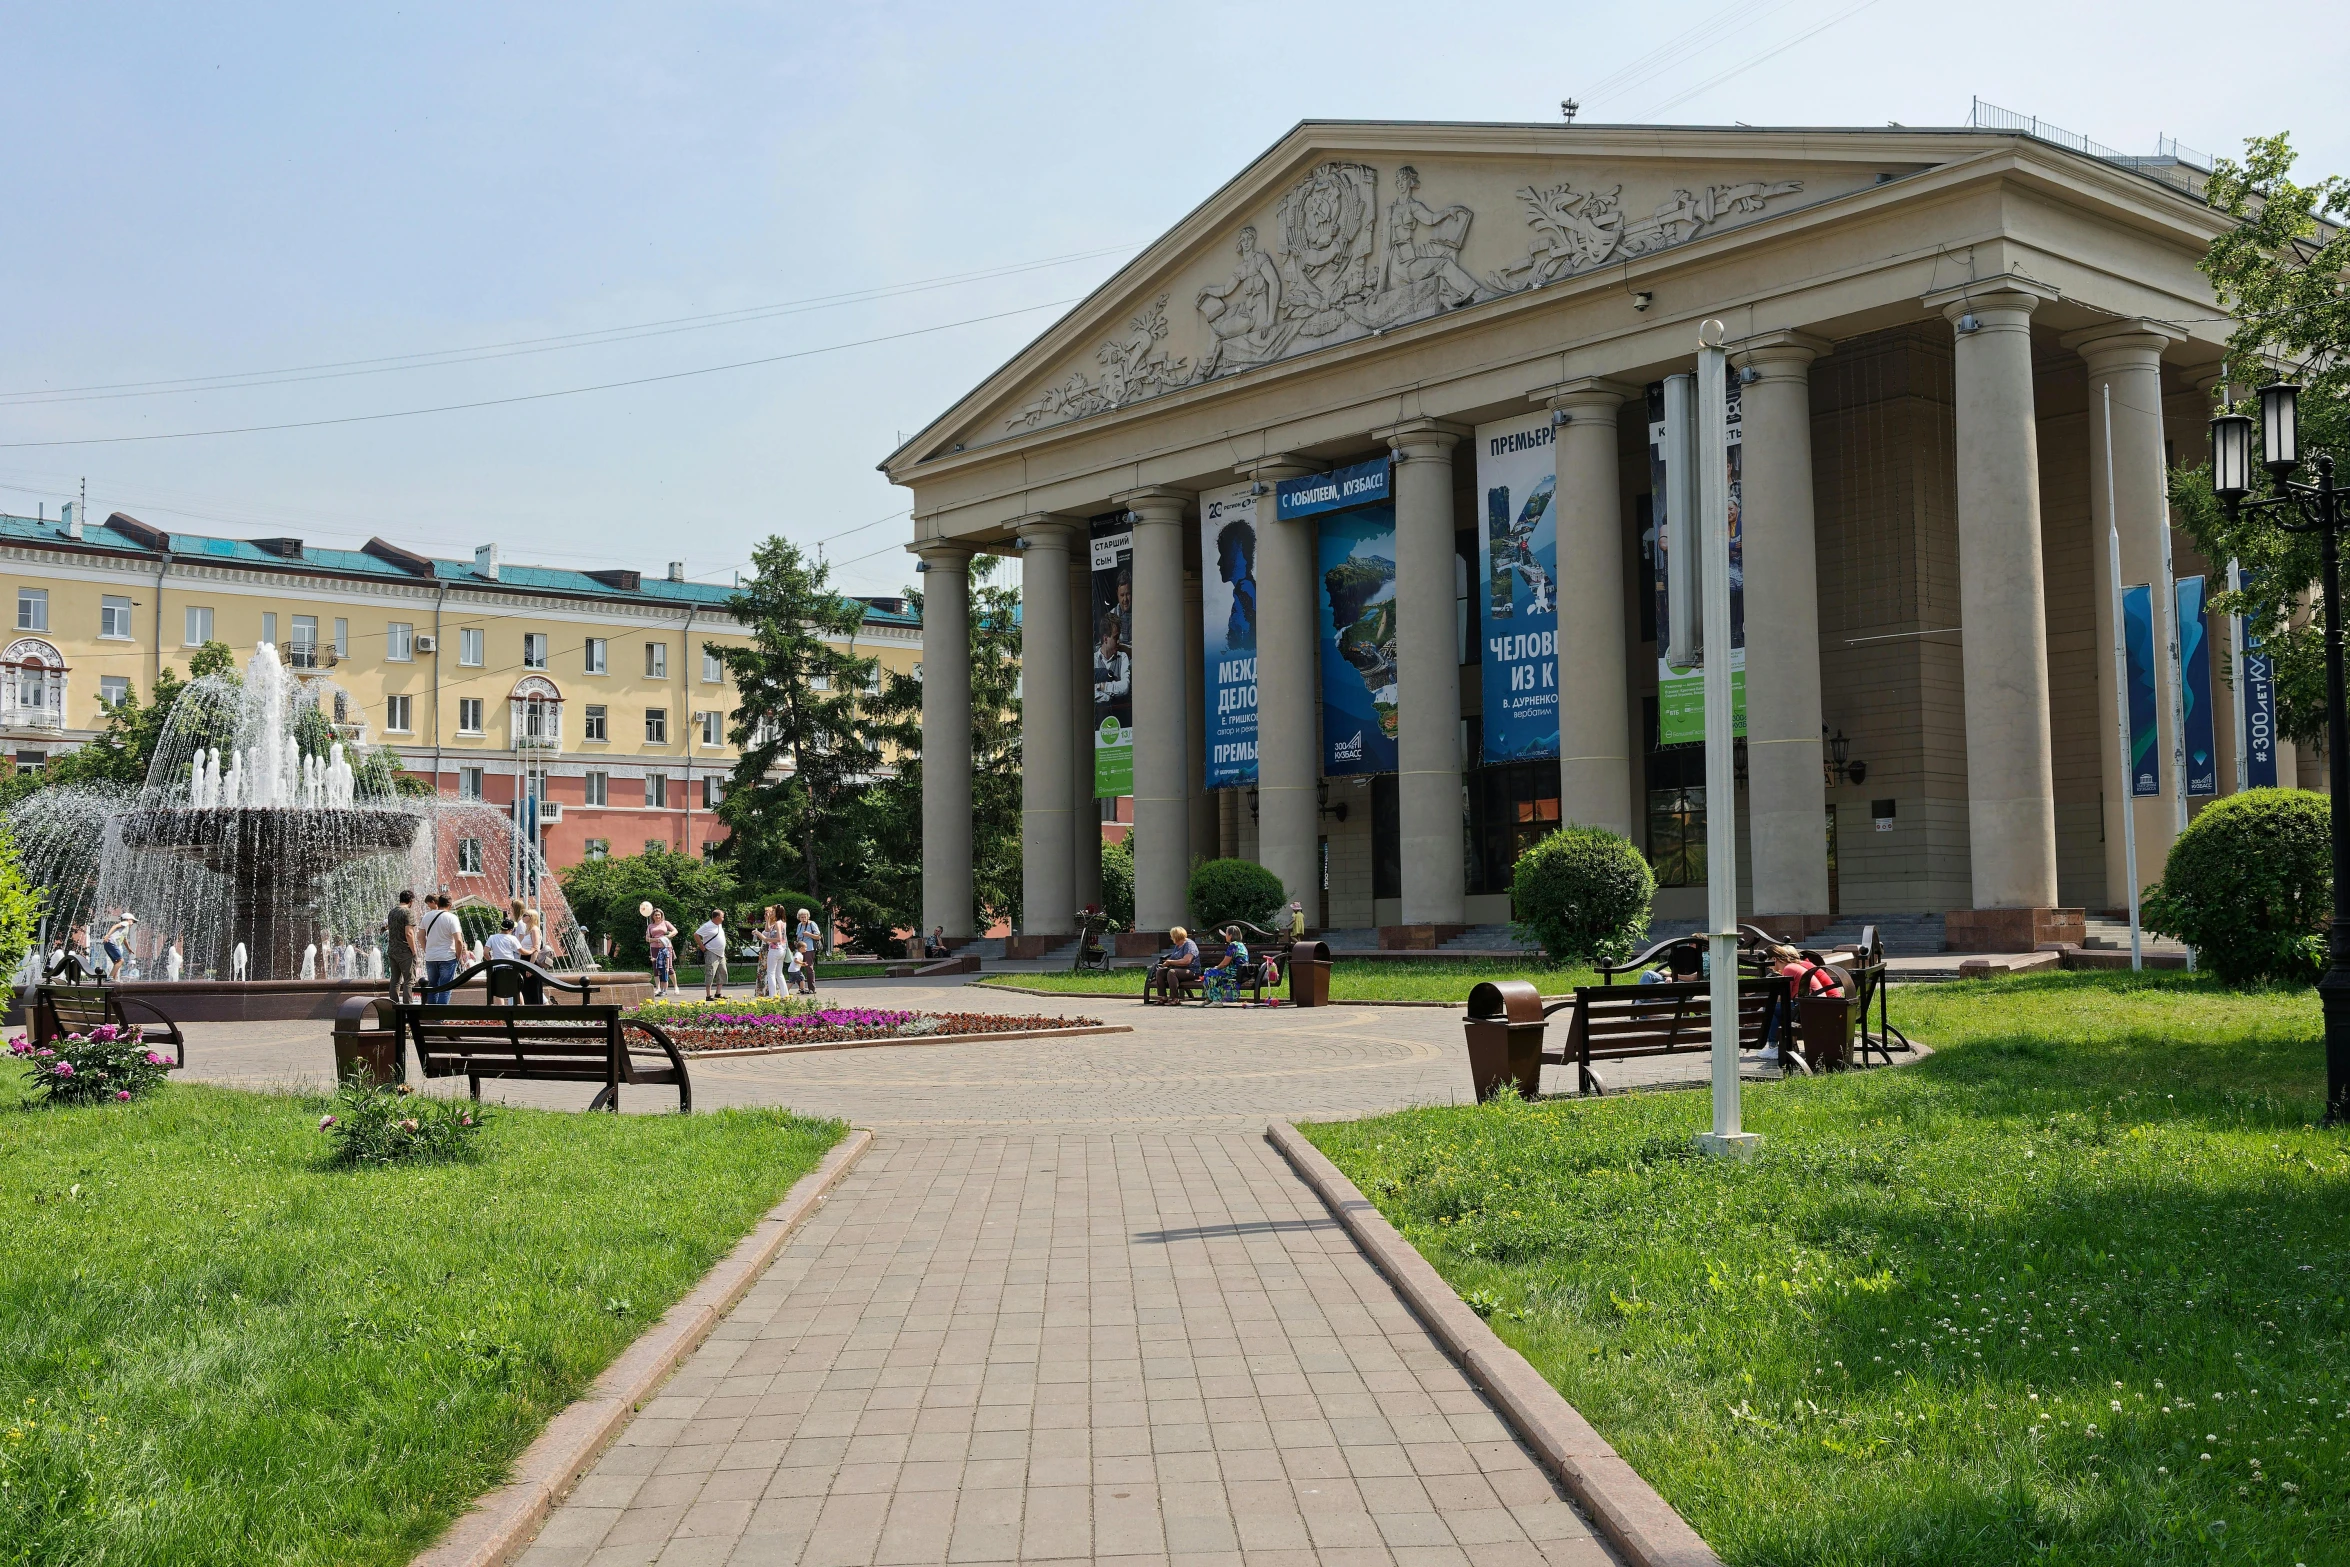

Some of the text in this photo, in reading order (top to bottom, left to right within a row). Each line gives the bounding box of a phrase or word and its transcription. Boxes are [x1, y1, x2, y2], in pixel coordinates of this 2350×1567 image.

[1490, 425, 1556, 457] ПРЕМЬЕРА
[1282, 472, 1383, 508] С ЮБИЛЕЕМ, КУЗБАСС!
[1094, 535, 1130, 551] СТАРШИЙ
[1095, 556, 1112, 566] СЫН
[1511, 662, 1555, 691] ИЗ К
[1217, 685, 1258, 715] ДЕЛО
[1502, 693, 1558, 709] В. ДУРНЕНКО
[1513, 707, 1552, 720] вербатим
[1221, 716, 1228, 726] Е.
[1216, 727, 1235, 736] автор
[1334, 741, 1347, 751] 300
[1334, 749, 1362, 760] КУЗБАСС
